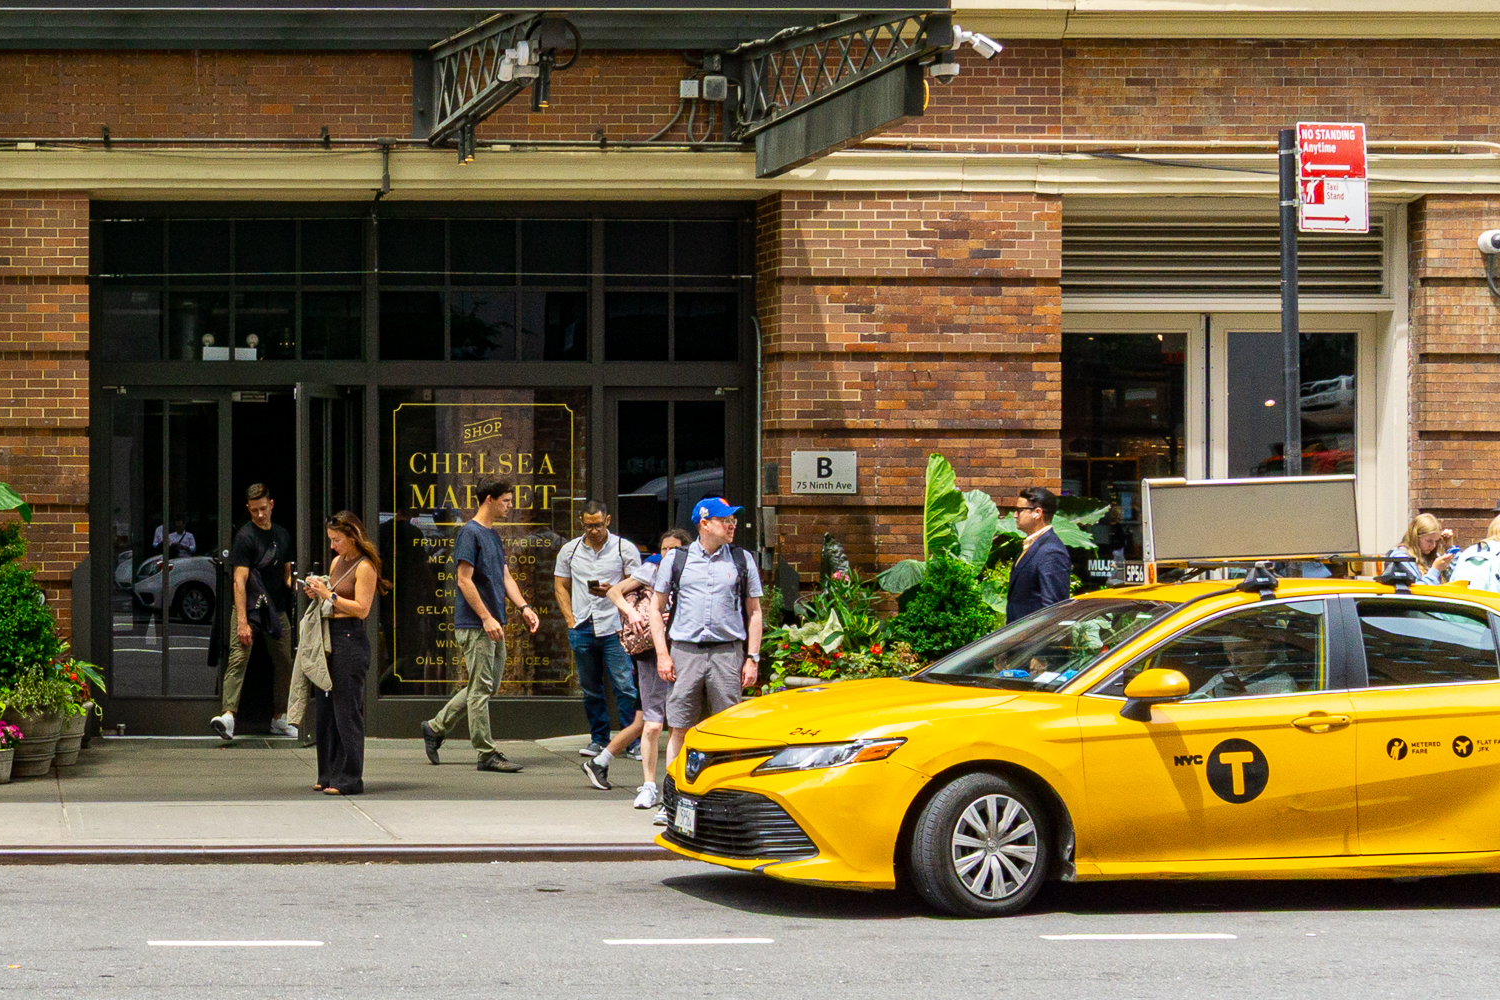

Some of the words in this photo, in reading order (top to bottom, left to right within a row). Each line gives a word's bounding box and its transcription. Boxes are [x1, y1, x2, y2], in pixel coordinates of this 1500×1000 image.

[1301, 129, 1314, 140] NO
[1315, 129, 1356, 140] STANDING
[1303, 142, 1337, 155] Anytime
[1326, 183, 1339, 191] Taxi
[1326, 192, 1345, 200] Stand
[463, 421, 502, 439] SHOP
[409, 452, 557, 475] CHELSEA
[816, 456, 834, 478] B
[796, 481, 808, 490] 75
[809, 481, 834, 490] Ninth
[835, 481, 852, 490] Ave
[409, 484, 557, 510] MARET
[412, 538, 455, 547] FRUITS
[416, 605, 455, 615] GELAT
[506, 606, 548, 615] CRAM
[435, 639, 458, 648] WIN
[415, 656, 448, 666] OILS,
[506, 656, 550, 666] SPICES
[1174, 754, 1204, 767] NYC
[1219, 751, 1254, 796] T
